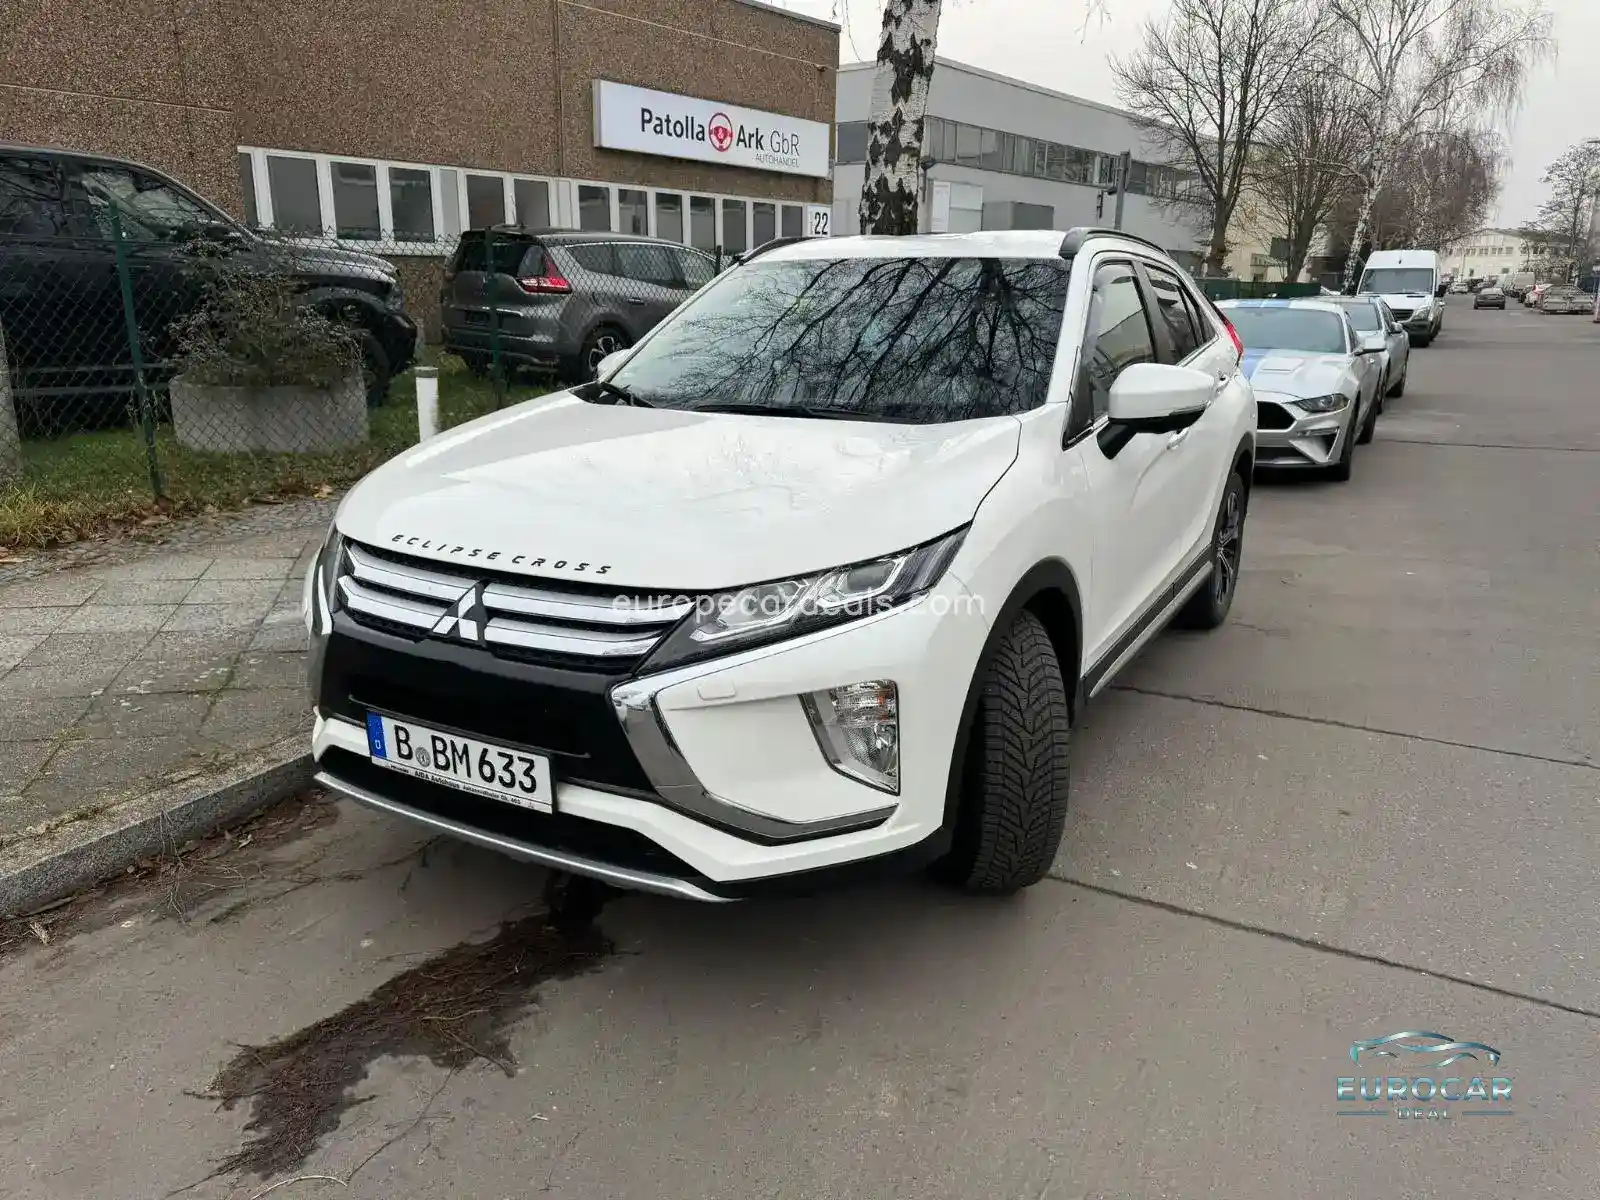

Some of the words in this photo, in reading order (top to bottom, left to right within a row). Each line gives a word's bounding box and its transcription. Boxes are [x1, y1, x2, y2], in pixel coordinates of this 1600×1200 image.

[640, 107, 705, 142] Patolla
[736, 124, 765, 151] Ark
[769, 130, 801, 156] GbR
[755, 153, 800, 168] AUTOHANDEL
[814, 211, 828, 235] 22
[391, 534, 501, 560] ECLIPSE
[511, 555, 611, 575] CROSS
[394, 724, 413, 761] B
[431, 734, 472, 779] BM
[478, 748, 537, 794] 633
